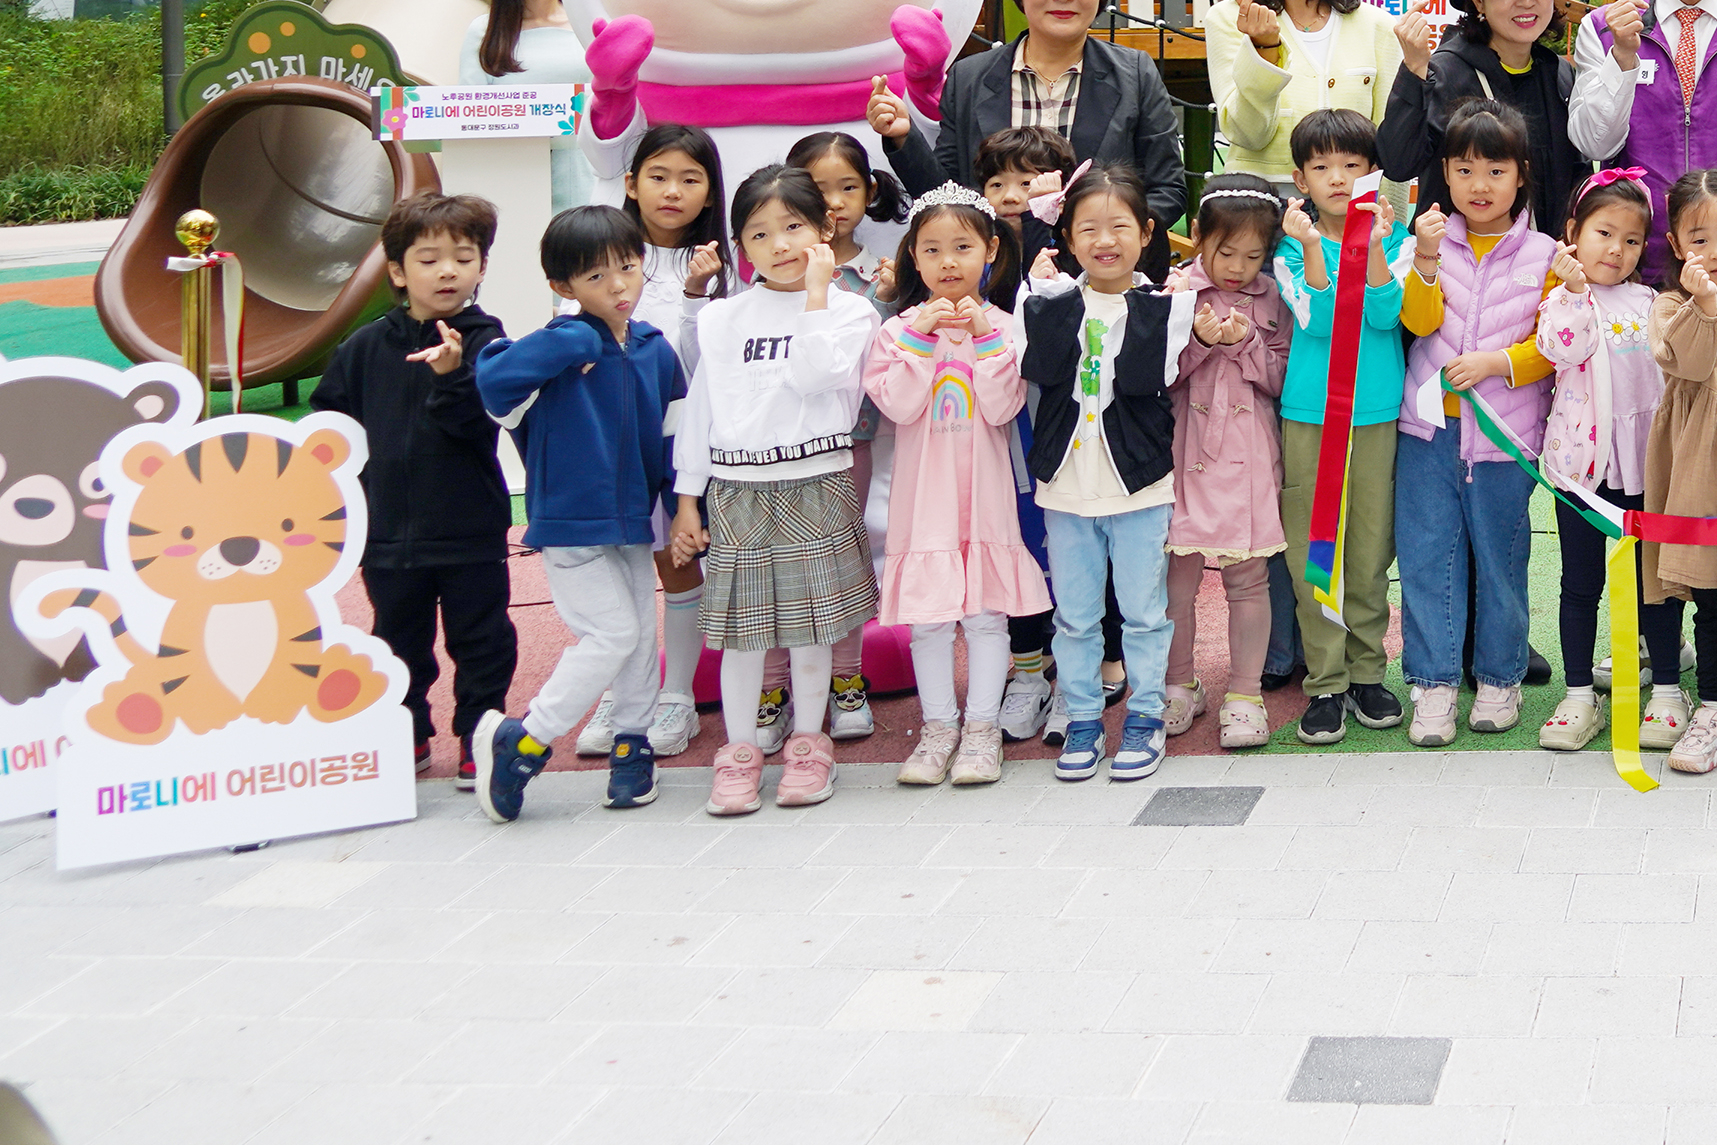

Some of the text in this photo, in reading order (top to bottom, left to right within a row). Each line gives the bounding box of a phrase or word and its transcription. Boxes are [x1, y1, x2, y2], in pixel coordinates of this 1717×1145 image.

[441, 91, 537, 101] 노후공원 환경개선사업 준공
[412, 103, 566, 119] 마로니에 어린이공원 개장식
[461, 123, 487, 131] 동대문구
[780, 445, 802, 460] YOU
[804, 438, 835, 456] WANT
[0, 739, 46, 776] 에
[97, 749, 380, 816] 마로니에 어린이공원
